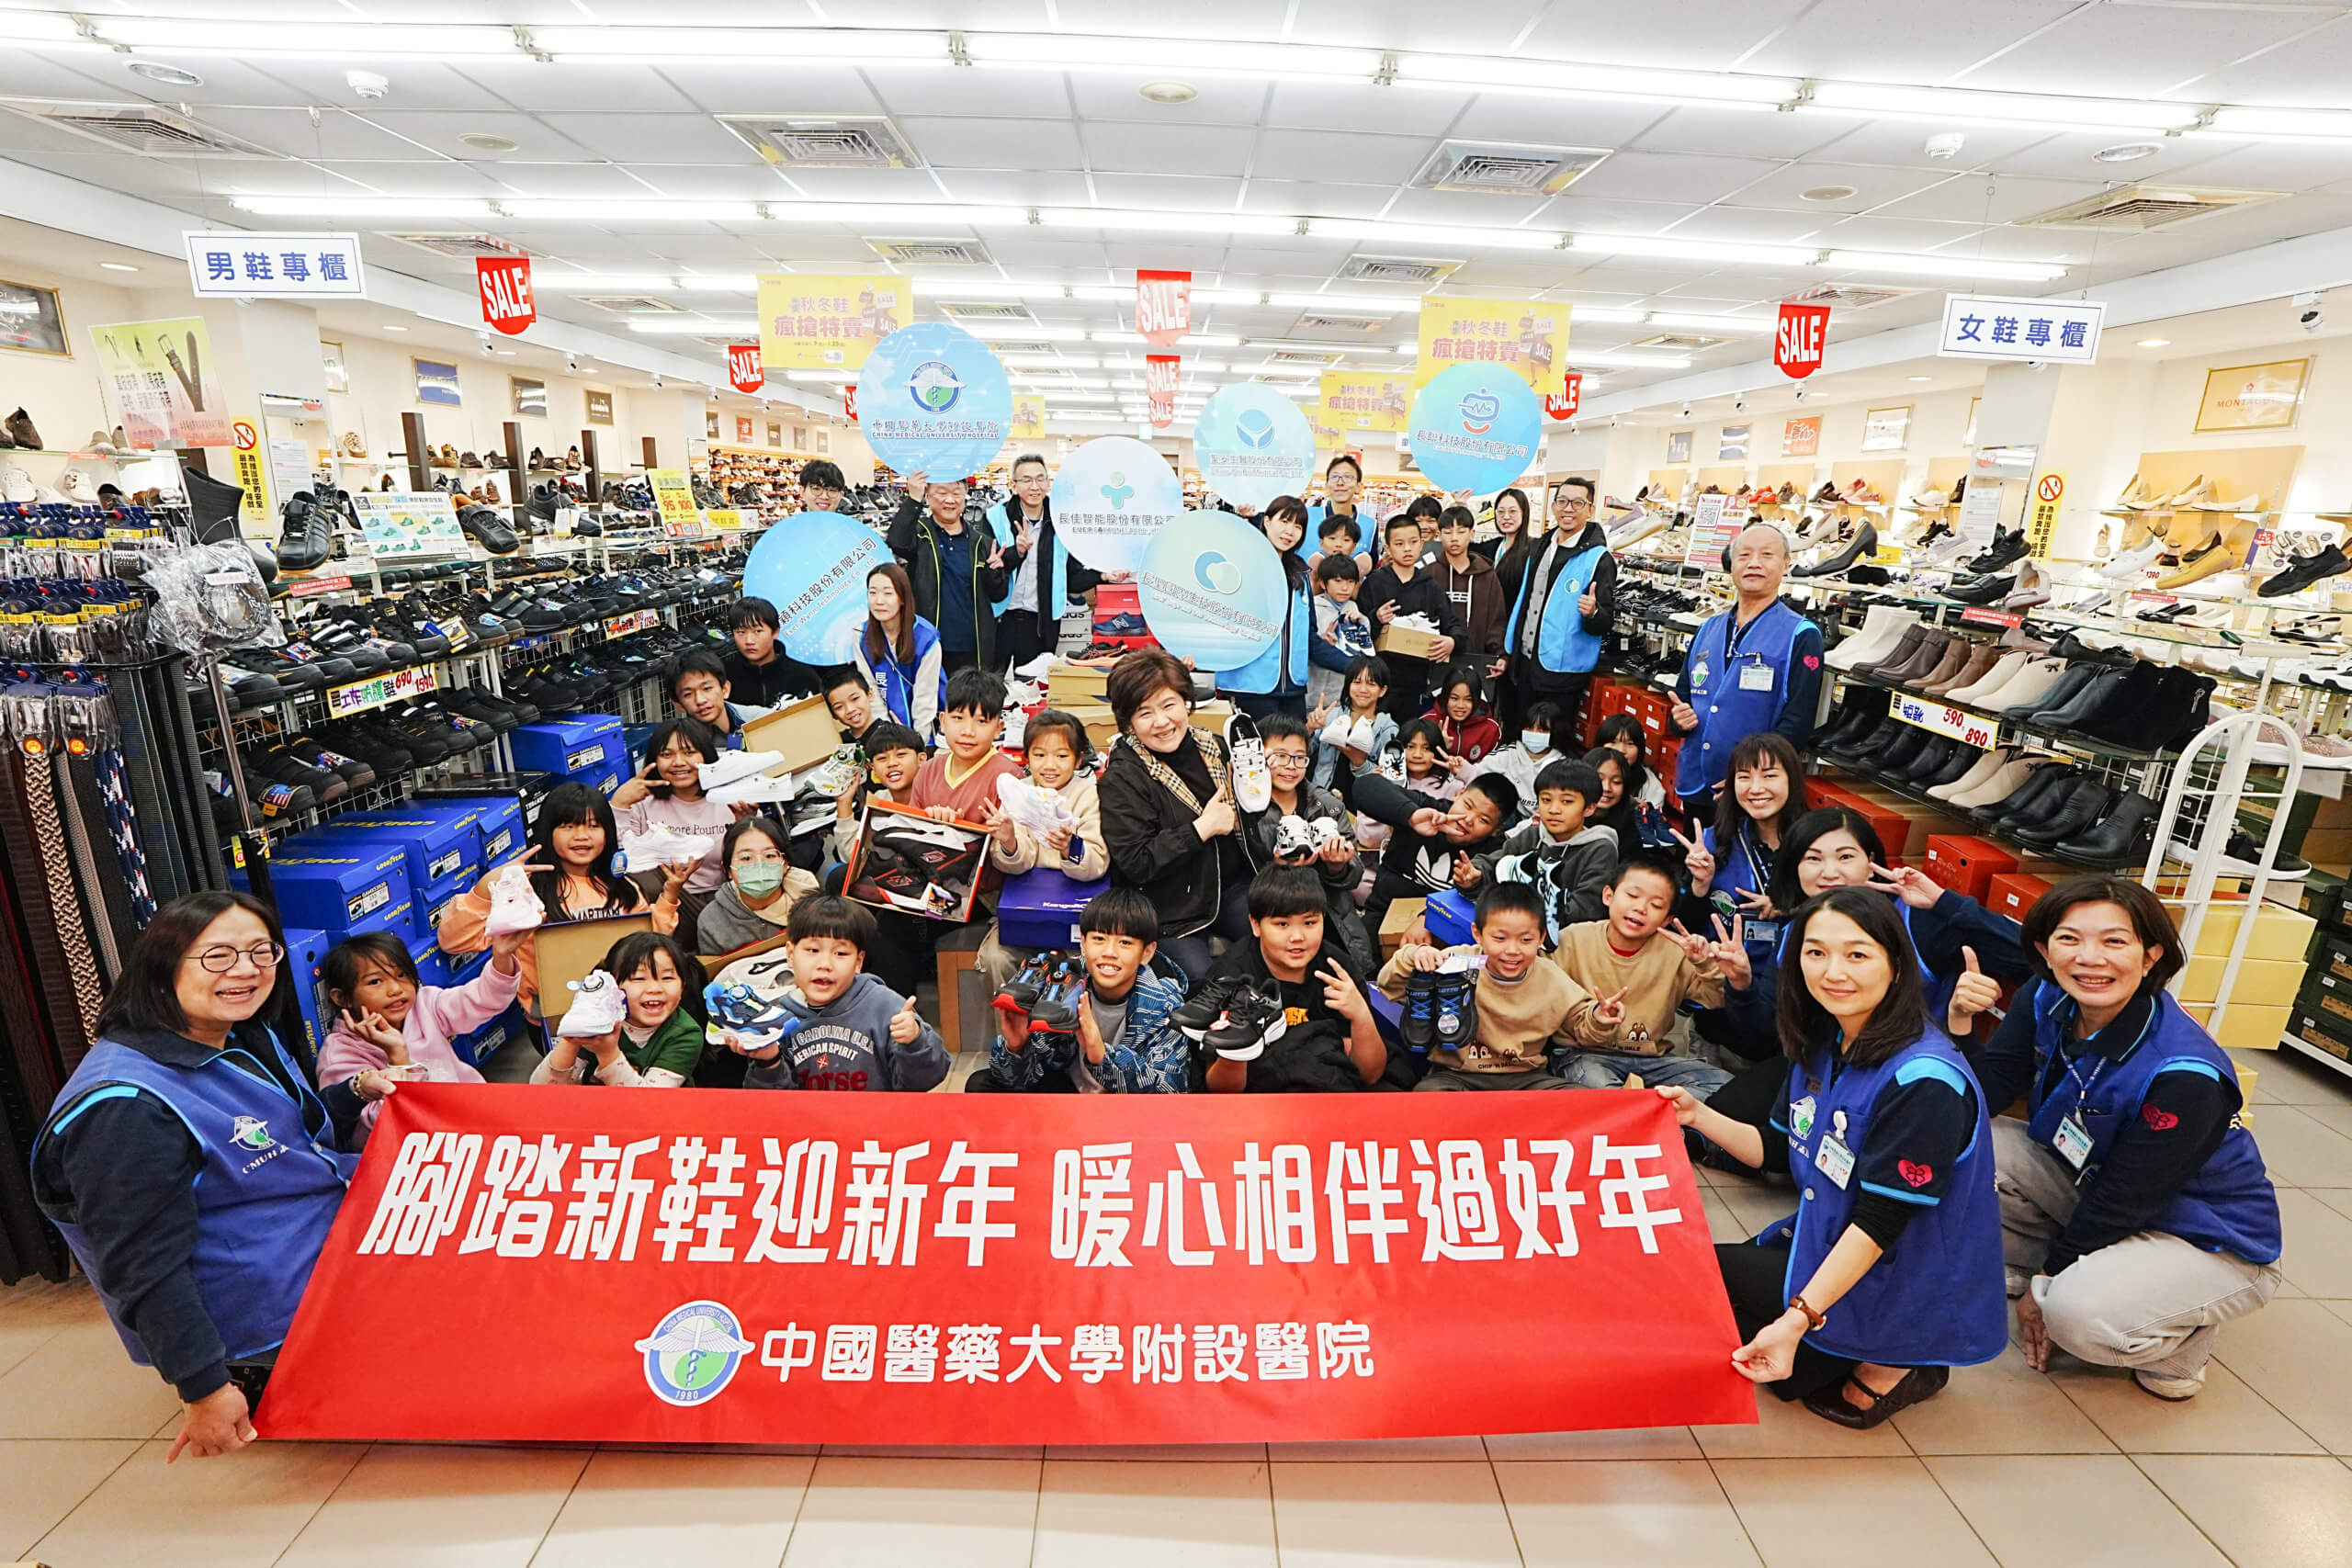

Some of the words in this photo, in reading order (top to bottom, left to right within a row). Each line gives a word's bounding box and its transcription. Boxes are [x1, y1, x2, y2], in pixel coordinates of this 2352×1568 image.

[205, 250, 349, 283] 男鞋專櫃
[481, 268, 532, 321] SALE
[801, 297, 849, 313] 秋冬鞋
[1139, 280, 1187, 333] SALE
[774, 315, 863, 338] 瘋搶特賣
[1462, 320, 1509, 337] 秋冬鞋
[1958, 313, 2088, 350] 女鞋專櫃
[1431, 338, 1521, 362] 瘋搶特賣
[1535, 343, 1553, 361] SALE
[1778, 313, 1823, 371] SALE
[730, 349, 762, 384] SALE
[1148, 360, 1178, 393] SALE
[846, 391, 857, 415] SA
[1548, 379, 1577, 412] SALE
[1149, 400, 1173, 423] SALE
[778, 536, 877, 626] 穎科技股份有限公司
[395, 671, 413, 690] 690
[414, 674, 435, 694] 1590
[594, 721, 622, 733] GOODYEAR
[1943, 708, 1964, 728] 590
[1965, 728, 1988, 747] 890
[454, 814, 478, 829] GOODYEAR
[375, 852, 405, 871] GOODYEAR
[454, 863, 478, 881] GOODYEAR
[384, 901, 412, 921] GOODYEAR
[796, 1024, 851, 1046] CAROLINA
[829, 1042, 859, 1061] SPIRIT
[242, 1150, 278, 1174] CMUH
[356, 1131, 1019, 1267] 腳踏新鞋迎新年
[1050, 1134, 1683, 1268] 暖心相伴過好年
[761, 1321, 1375, 1385] 中國醫藥大學附設醫院
[675, 1390, 699, 1400] 1980
